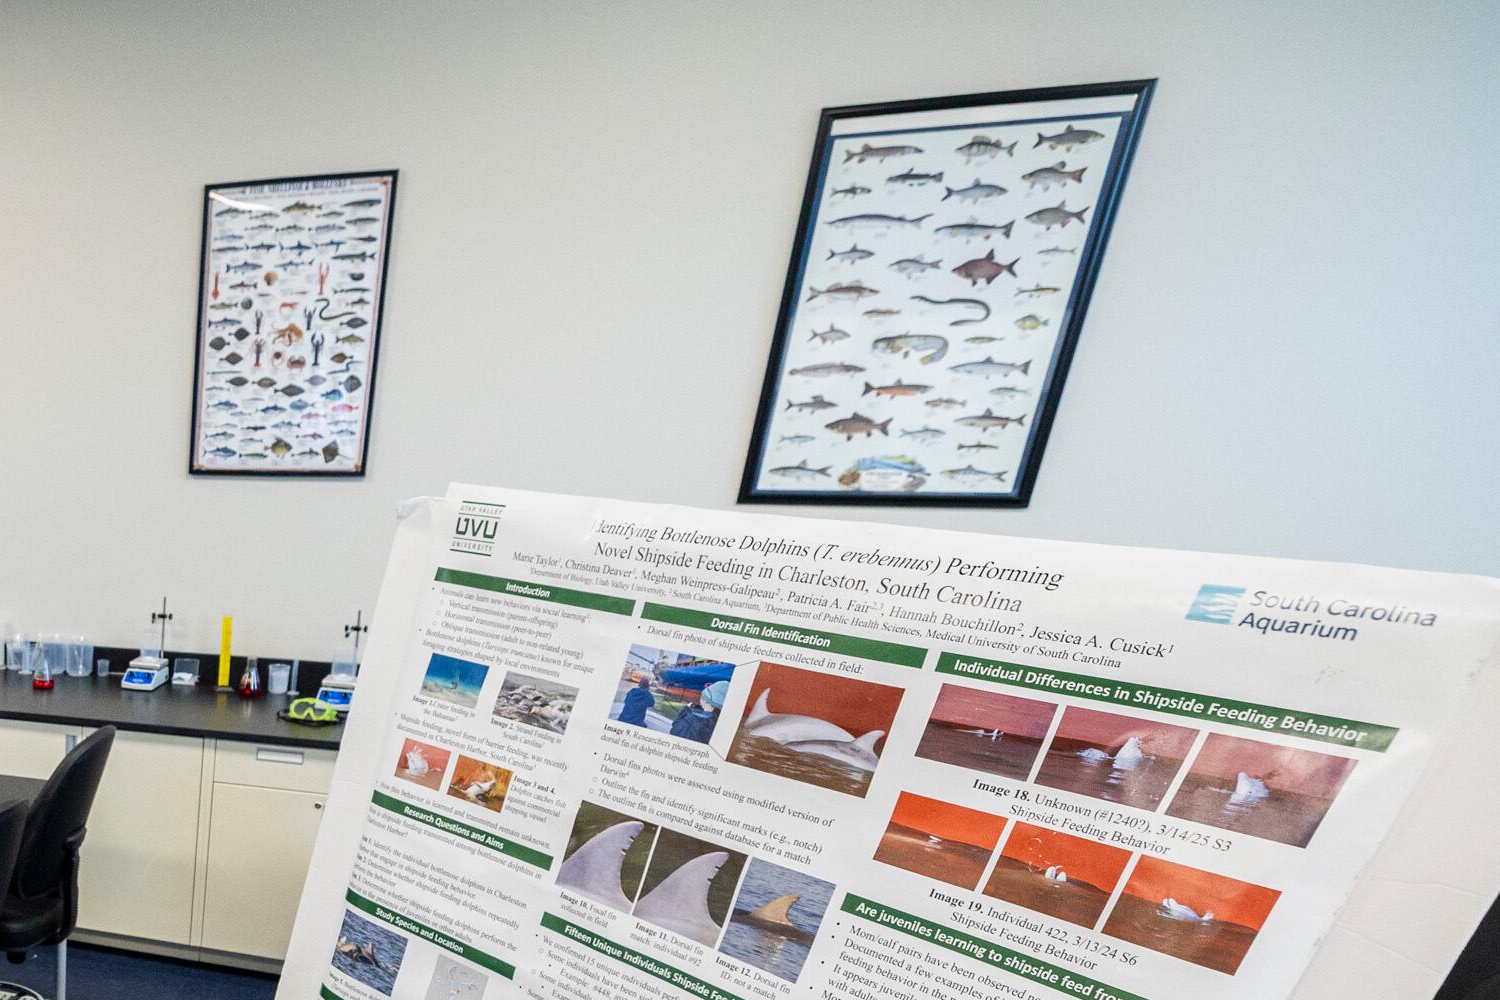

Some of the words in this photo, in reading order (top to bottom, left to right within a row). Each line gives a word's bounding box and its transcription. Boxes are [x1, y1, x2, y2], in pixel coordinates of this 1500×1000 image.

[455, 517, 498, 539] UVU
[594, 542, 633, 559] Novel
[635, 547, 692, 567] Shipside
[696, 554, 754, 580] Feeding
[757, 562, 773, 578] in
[778, 565, 868, 592] Charleston,
[876, 577, 929, 599] South
[936, 585, 1021, 612] Carolina
[660, 527, 735, 548] Bottlenose
[738, 535, 810, 556] Dolphins
[813, 544, 839, 561] (T.
[945, 558, 1064, 591] Performing
[505, 582, 550, 598] Introduction
[512, 551, 534, 563] Marie
[565, 559, 600, 573] Christina
[640, 570, 677, 584] Meghan
[787, 591, 828, 607] Patricia
[889, 605, 937, 623] Hannah
[1029, 626, 1081, 645] Jessica
[1084, 635, 1102, 648] A.
[1249, 590, 1319, 613] South
[1326, 599, 1437, 627] Carolina
[710, 617, 744, 631] Dorsal
[743, 623, 759, 635] Fin
[761, 626, 830, 647] Identification
[1238, 612, 1357, 640] Aquarium
[954, 659, 1023, 681] Individual
[1024, 671, 1111, 696] Differences
[1114, 686, 1130, 700] in
[1133, 690, 1204, 713] Shipside
[1207, 702, 1278, 728] Feeding
[1280, 716, 1368, 743] Behavior
[404, 806, 434, 823] Research
[434, 817, 470, 836] Questions
[470, 832, 486, 842] and
[485, 836, 504, 849] Aims
[973, 779, 1010, 796] Image
[1014, 789, 1029, 801] 18.
[1035, 794, 1091, 816] Unknown
[1156, 824, 1210, 845] 3/14/25
[1212, 838, 1232, 851] S3
[1009, 804, 1058, 825] Shipside
[1061, 817, 1108, 841] Feeding
[1110, 830, 1170, 854] Behavior
[375, 907, 395, 922] Study
[395, 916, 419, 933] Species
[420, 929, 434, 939] and
[434, 934, 463, 953] Location
[855, 902, 877, 917] Are
[877, 909, 932, 936] juveniles
[934, 928, 986, 958] learning
[988, 949, 1002, 961] to
[1003, 956, 1058, 983] shipside
[1060, 975, 1094, 996] feed
[929, 888, 964, 907] Image
[968, 901, 983, 913] 19.
[987, 907, 1044, 933] Individual
[1045, 927, 1068, 943] 422,
[1072, 935, 1118, 958] 3/13/24
[1119, 952, 1138, 965] S6
[950, 911, 997, 934] Shipside
[999, 927, 1042, 951] Feeding
[1044, 944, 1097, 970] Behavior
[564, 925, 591, 943] Fifteen
[592, 937, 622, 957] Unique
[623, 951, 671, 978] Individuals
[672, 972, 709, 996] Shipside
